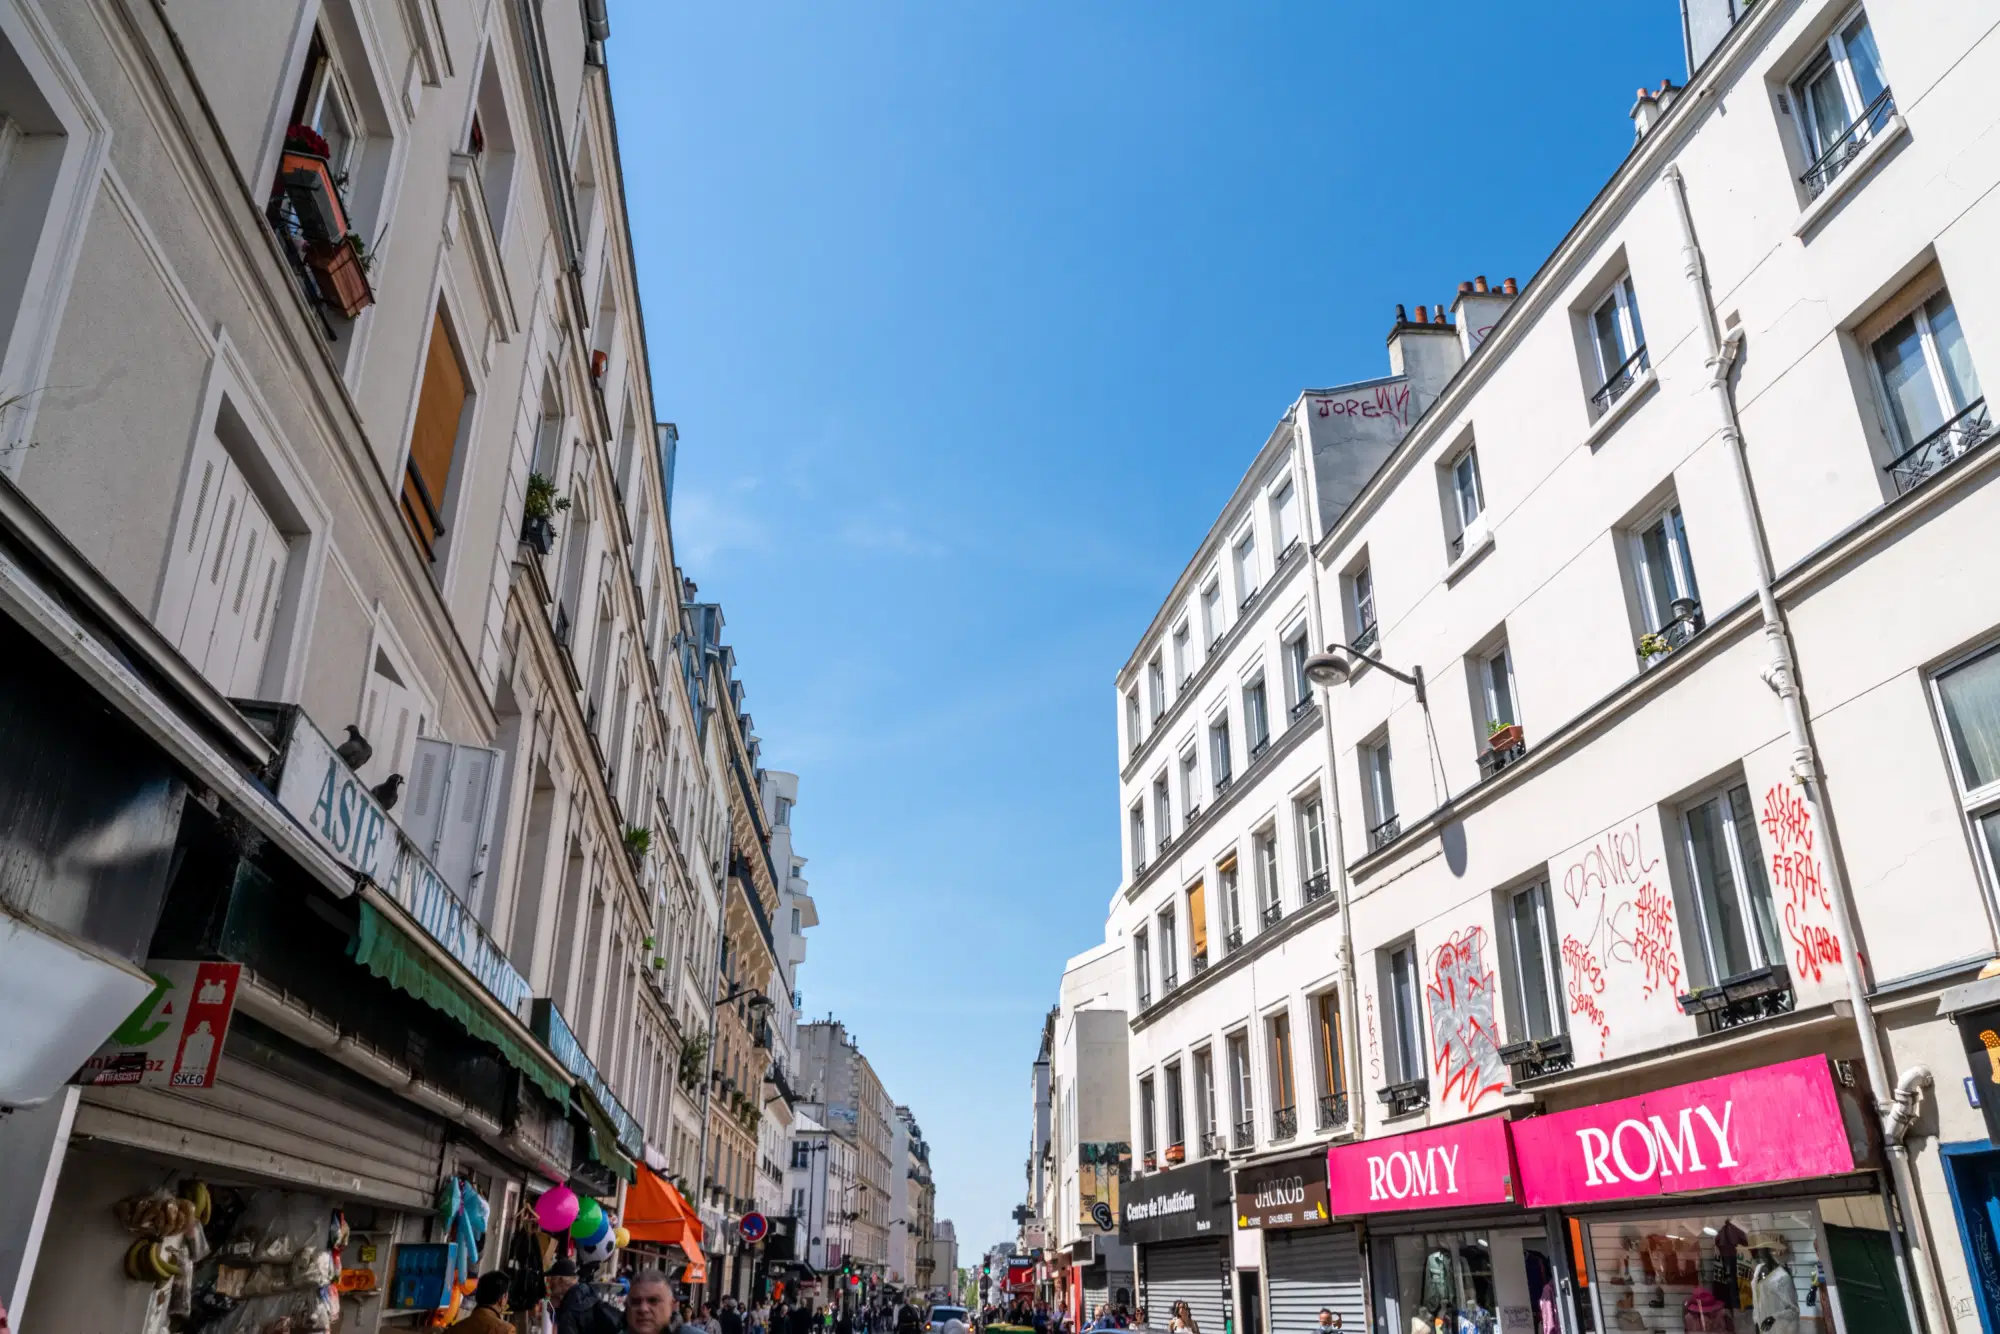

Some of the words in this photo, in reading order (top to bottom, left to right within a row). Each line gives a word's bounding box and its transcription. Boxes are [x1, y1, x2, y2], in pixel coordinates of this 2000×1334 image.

[309, 756, 385, 878] ASIE
[1564, 824, 1659, 908] DANIEL
[174, 1073, 204, 1085] SKEO
[1367, 1143, 1460, 1201] ROMY
[1576, 1100, 1739, 1186] ROMY
[1127, 1202, 1148, 1221] Centre
[1149, 1197, 1157, 1217] de
[1157, 1188, 1195, 1216] l'Audition
[1255, 1176, 1305, 1209] JACKOB
